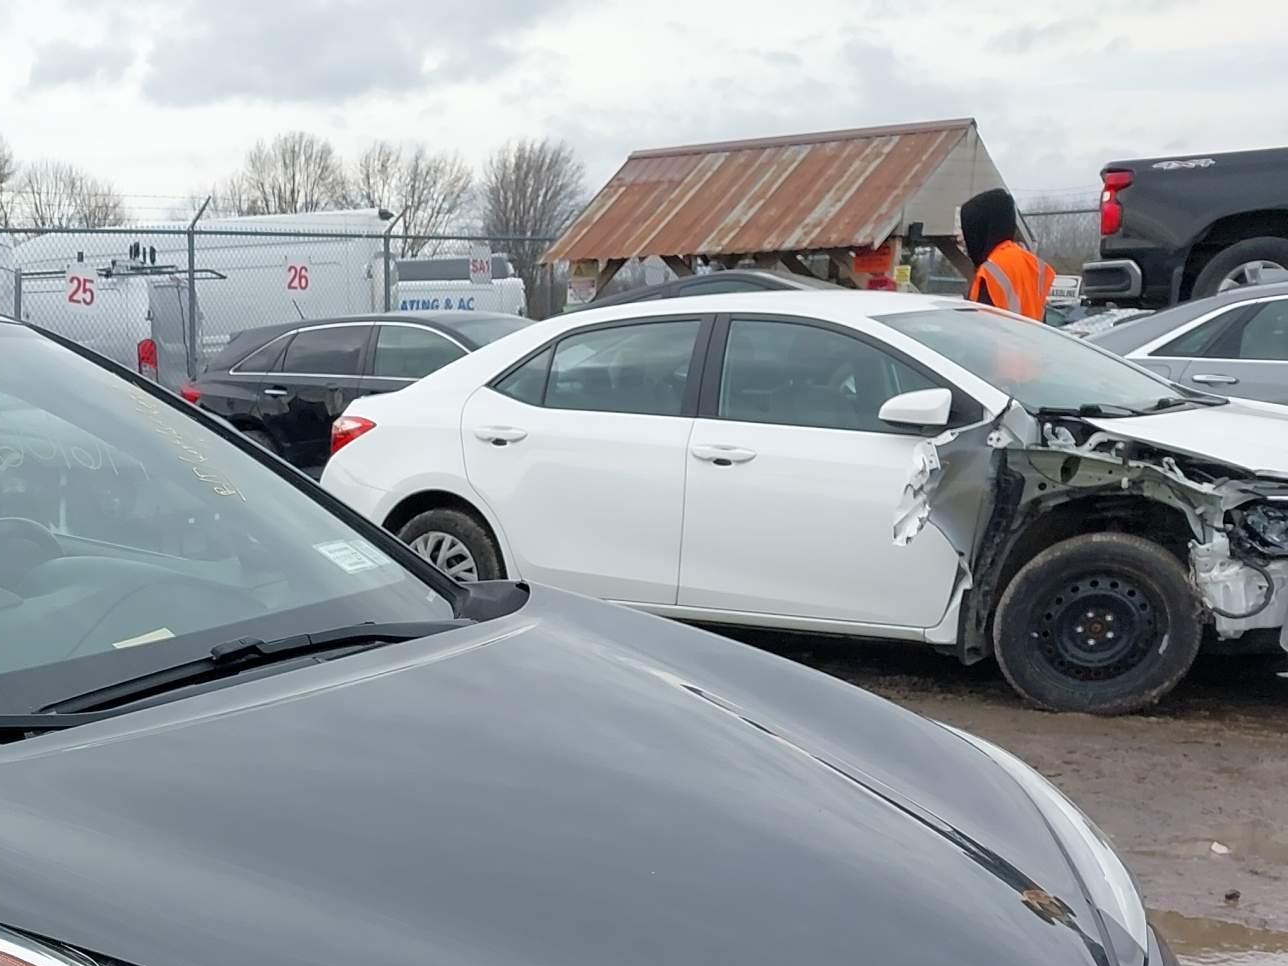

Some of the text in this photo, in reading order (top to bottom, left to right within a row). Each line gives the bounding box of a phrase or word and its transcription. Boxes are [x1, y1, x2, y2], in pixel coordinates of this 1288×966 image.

[287, 266, 309, 290] 26
[68, 276, 95, 306] 25
[444, 298, 454, 310] &
[458, 297, 475, 311] AC
